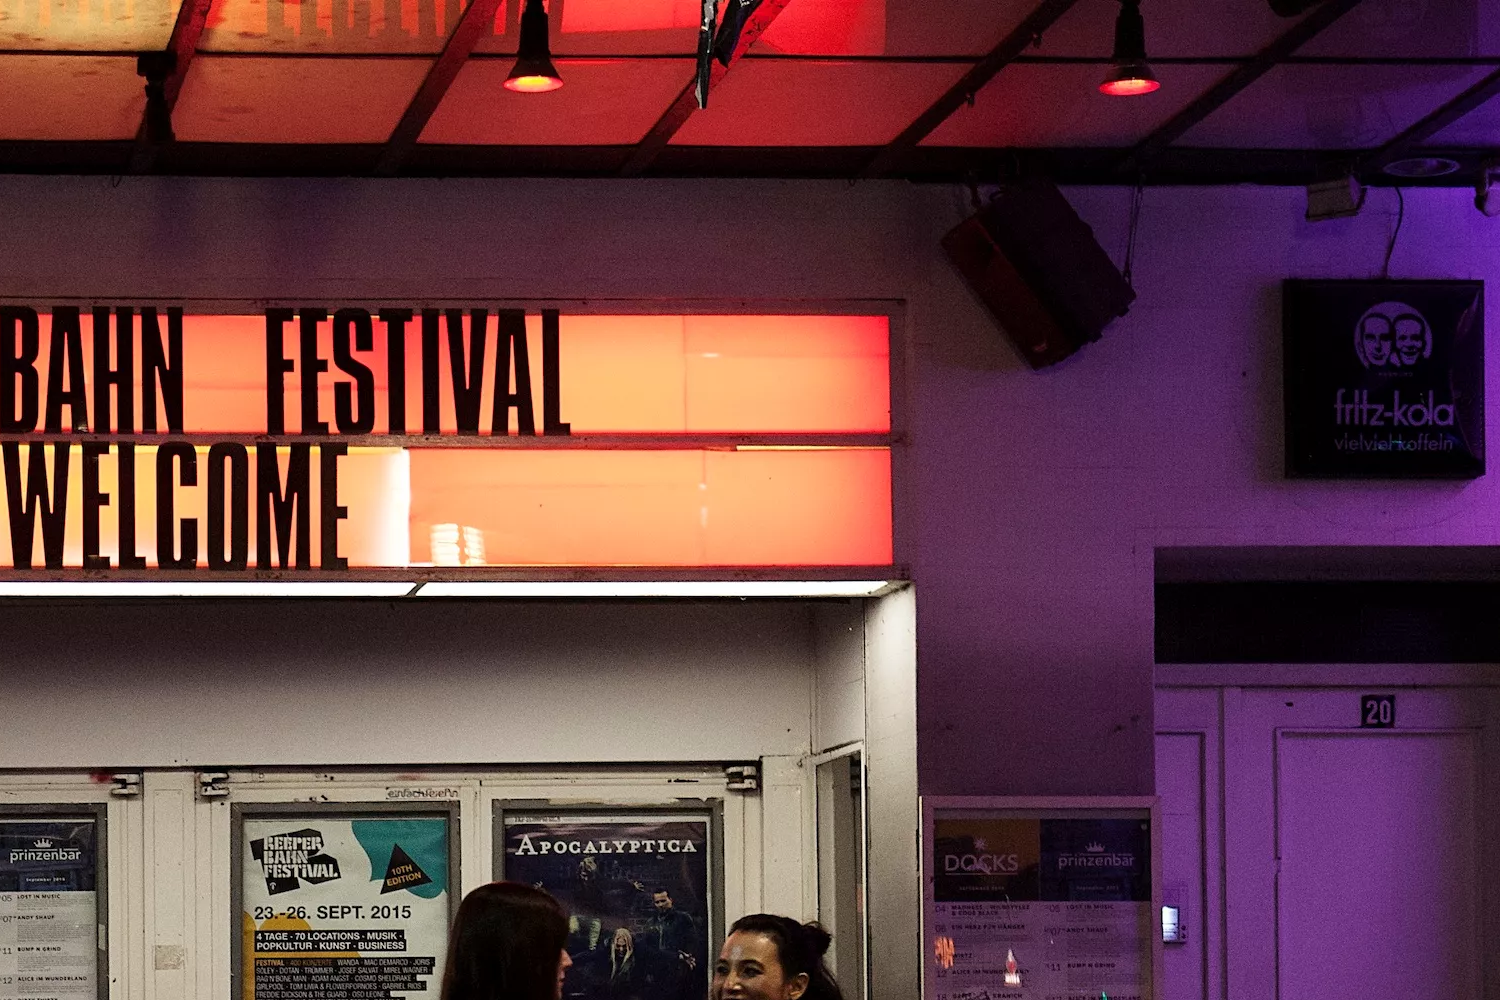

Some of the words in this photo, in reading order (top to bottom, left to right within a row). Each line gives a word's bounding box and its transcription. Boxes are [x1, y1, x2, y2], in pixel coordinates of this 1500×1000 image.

[264, 308, 571, 436] FESTIVAL
[1333, 387, 1454, 427] fritz-kola
[2, 440, 349, 570] WELCOME
[1364, 700, 1392, 726] 20
[263, 836, 322, 850] REEPER
[515, 834, 698, 856] APOCALYPTICA
[9, 848, 82, 864] prinzenbar
[263, 850, 308, 864] BAHN
[944, 853, 1019, 872] DOCKS
[1058, 853, 1135, 869] prinzenbar
[263, 863, 338, 878] FESTIVAL
[390, 864, 413, 876] 10TH
[386, 871, 422, 887] EDITION
[254, 906, 311, 920] 23.-26.
[316, 905, 366, 919] SEPT.
[371, 905, 411, 919] 2015
[256, 932, 262, 940] 4
[264, 932, 288, 940] TAGE
[295, 932, 306, 940] 70
[307, 932, 360, 940] LOCATIONS
[367, 932, 397, 940] MUSIK
[257, 942, 312, 950] POPKULTUR
[319, 941, 352, 950] KUNST
[357, 941, 405, 950] BUSINESS
